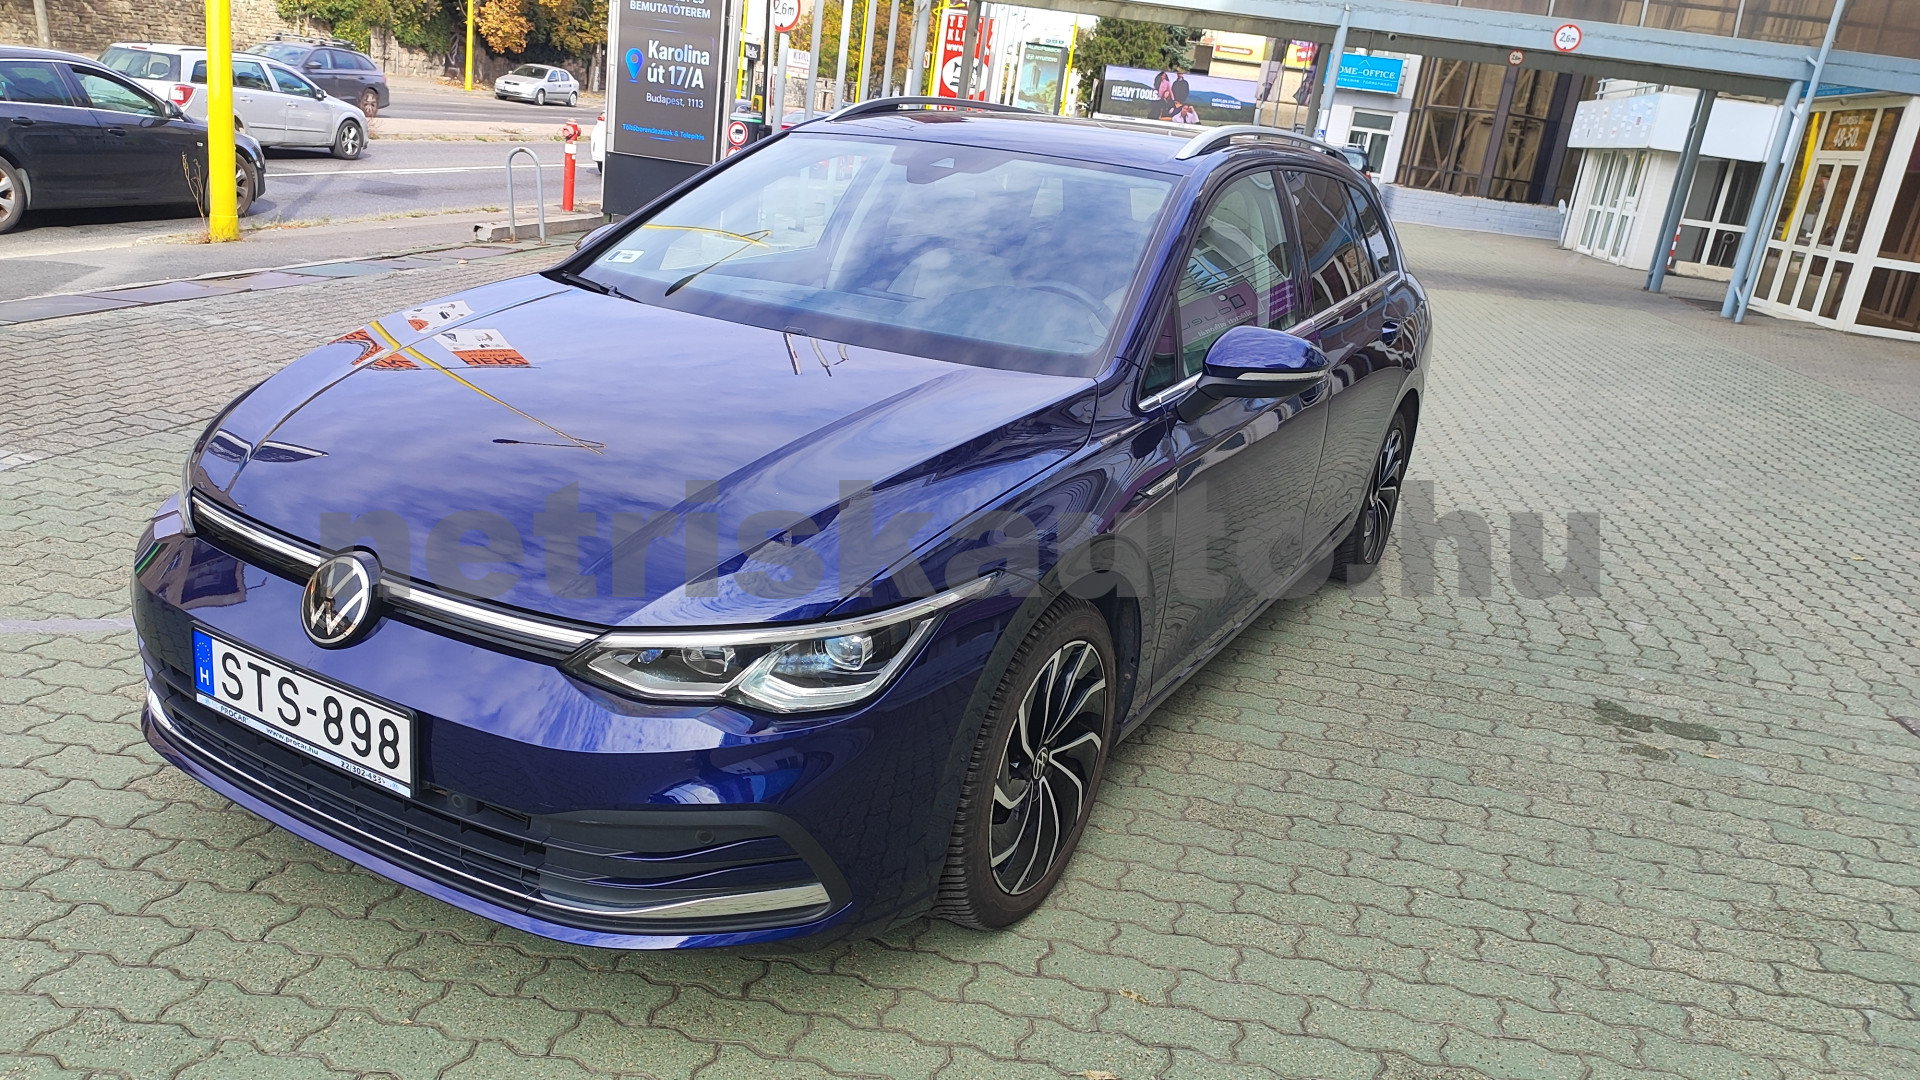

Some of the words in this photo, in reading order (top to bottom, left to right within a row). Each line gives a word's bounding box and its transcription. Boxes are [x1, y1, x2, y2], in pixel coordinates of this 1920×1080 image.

[629, 1, 711, 19] BEMUTATÓTEREM
[648, 39, 710, 66] Karolina
[647, 62, 666, 84] út
[668, 65, 705, 89] 17/A
[646, 92, 685, 107] Budapest,
[687, 98, 704, 109] 1113
[200, 666, 210, 686] H
[221, 651, 400, 770] STS-898
